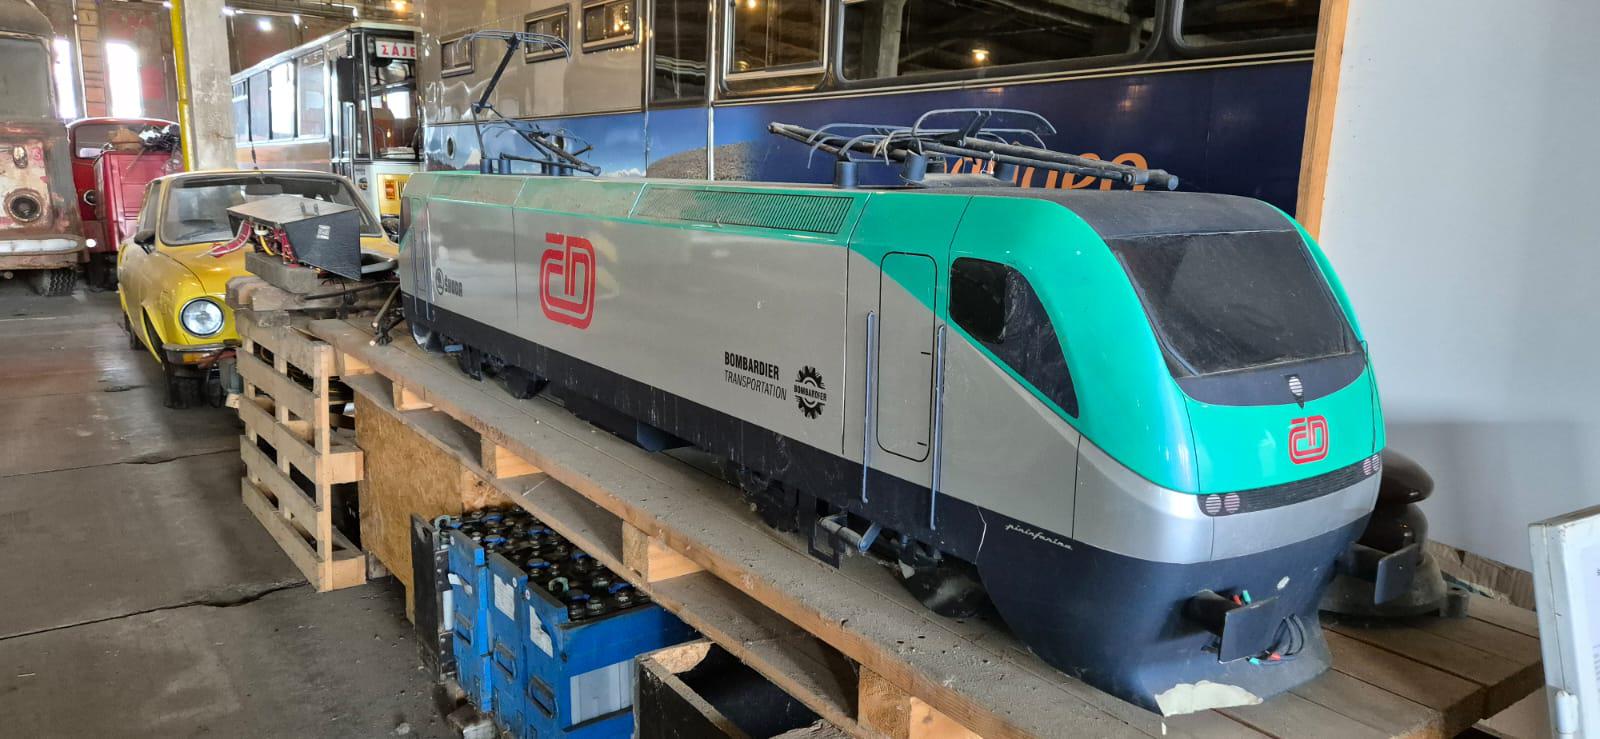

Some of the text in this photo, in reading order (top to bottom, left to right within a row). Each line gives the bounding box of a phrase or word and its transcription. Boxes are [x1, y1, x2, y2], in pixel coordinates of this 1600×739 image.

[724, 351, 780, 381] BOMBARDIER
[724, 369, 787, 401] TRANSPORTATION
[794, 384, 827, 402] BOMBARDIER
[1004, 523, 1073, 551] pininfarina
